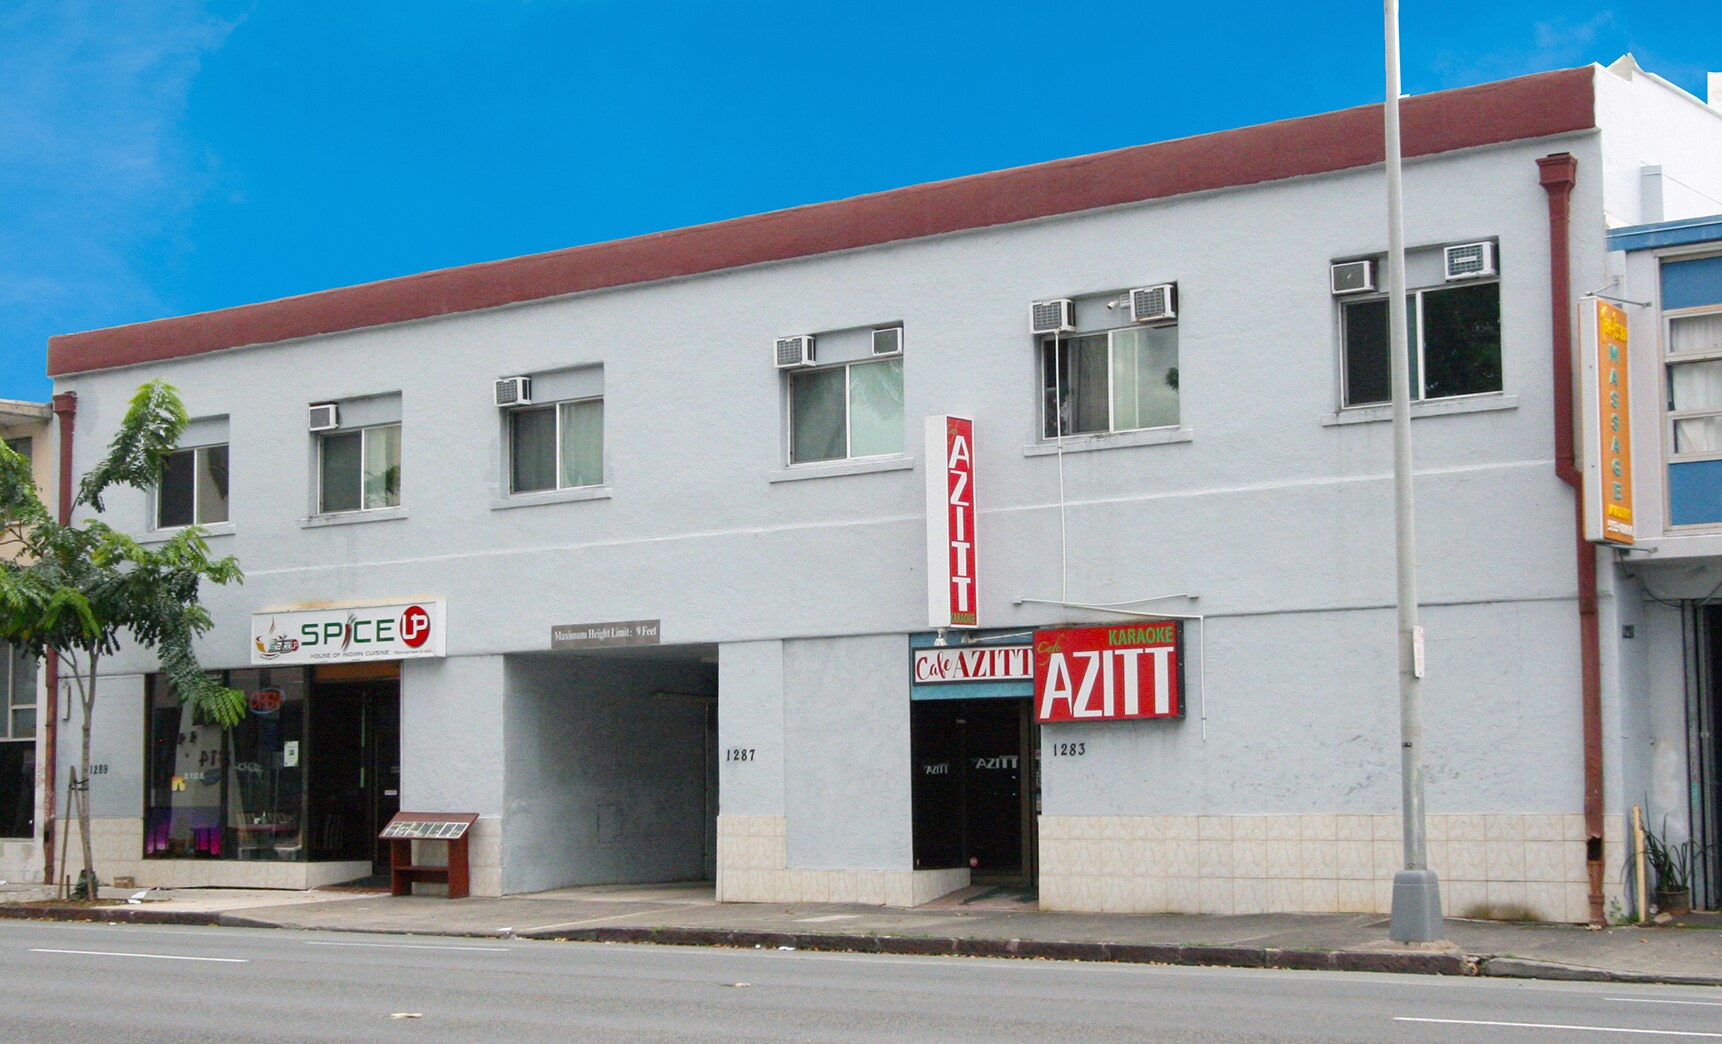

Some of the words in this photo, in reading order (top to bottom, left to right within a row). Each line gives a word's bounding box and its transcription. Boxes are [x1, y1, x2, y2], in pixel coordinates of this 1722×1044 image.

[1608, 343, 1623, 501] MASSAGE
[948, 435, 972, 612] AZITT
[301, 612, 395, 650] SPICE
[402, 614, 428, 640] UP
[554, 629, 587, 641] Maximum
[588, 628, 611, 641] Height
[611, 627, 633, 638] Limit:
[636, 626, 641, 636] 9
[641, 625, 657, 636] Feet
[1108, 625, 1174, 646] KARAOKE
[916, 650, 952, 680] Cafe
[952, 648, 1034, 679] AZITT
[1039, 646, 1175, 720] AZITT
[727, 749, 756, 762] 1287
[1053, 743, 1086, 757] 1283
[89, 765, 108, 775] 1289
[925, 763, 949, 775] AZITT
[976, 755, 1019, 769] AZITT
